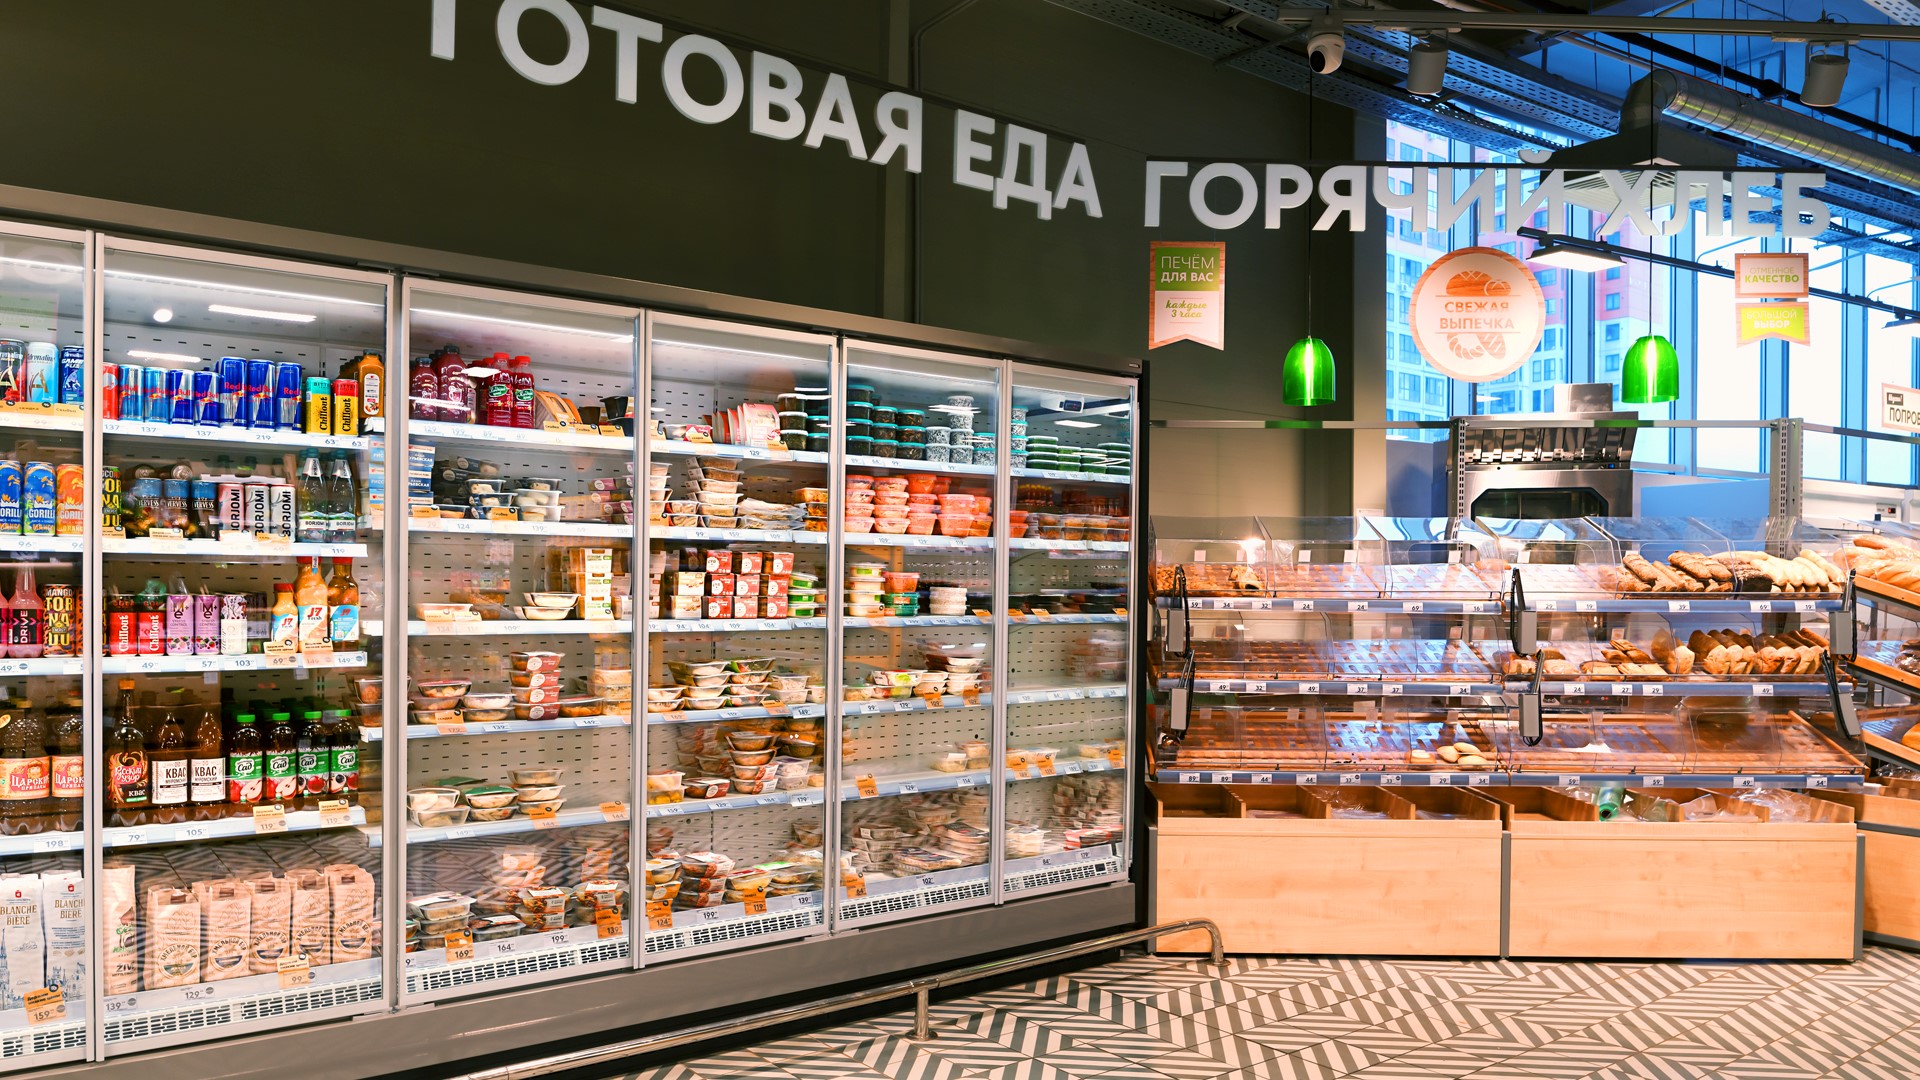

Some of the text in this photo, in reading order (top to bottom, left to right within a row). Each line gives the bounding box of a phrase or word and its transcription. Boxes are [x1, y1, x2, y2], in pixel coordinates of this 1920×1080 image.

[955, 109, 1102, 219] ЕДА
[1144, 148, 1831, 238] ГОРЯЧИЙ ХЛЕБ
[1161, 254, 1215, 269] ПЕЧЁМ
[1749, 266, 1794, 274] ОТМЕННОЕ
[1160, 272, 1214, 283] ДЛЯ ВАС
[1745, 274, 1799, 284] КАЧЕСТВО
[1165, 300, 1207, 311] каждые
[1444, 301, 1510, 313] СВЕЖАЯ
[1171, 309, 1178, 318] 3
[1746, 309, 1797, 320] БОЛЬШОЙ
[1439, 317, 1515, 330] ВЫПЕЧКА
[1753, 320, 1791, 330] ВЫБОР
[224, 382, 241, 391] Red
[283, 387, 298, 395] Red
[319, 396, 328, 431] Chillout
[342, 397, 351, 432] Chillout
[307, 607, 323, 617] J7
[282, 618, 293, 626] J7
[118, 614, 129, 652] Chillout
[149, 613, 160, 651] Chillout
[235, 659, 251, 667] 103
[165, 767, 187, 778] КВАС
[194, 766, 217, 777] КВАС
[120, 774, 140, 783] узор
[186, 828, 203, 836] 105
[128, 834, 140, 842] 79
[46, 840, 64, 848] 198
[0, 905, 37, 915] BLANCHE
[6, 914, 30, 926] BIÈRE
[607, 926, 619, 934] 139
[455, 950, 470, 959] 169
[185, 991, 200, 999] 129
[105, 1002, 121, 1010] 139
[34, 1011, 50, 1020] 159
